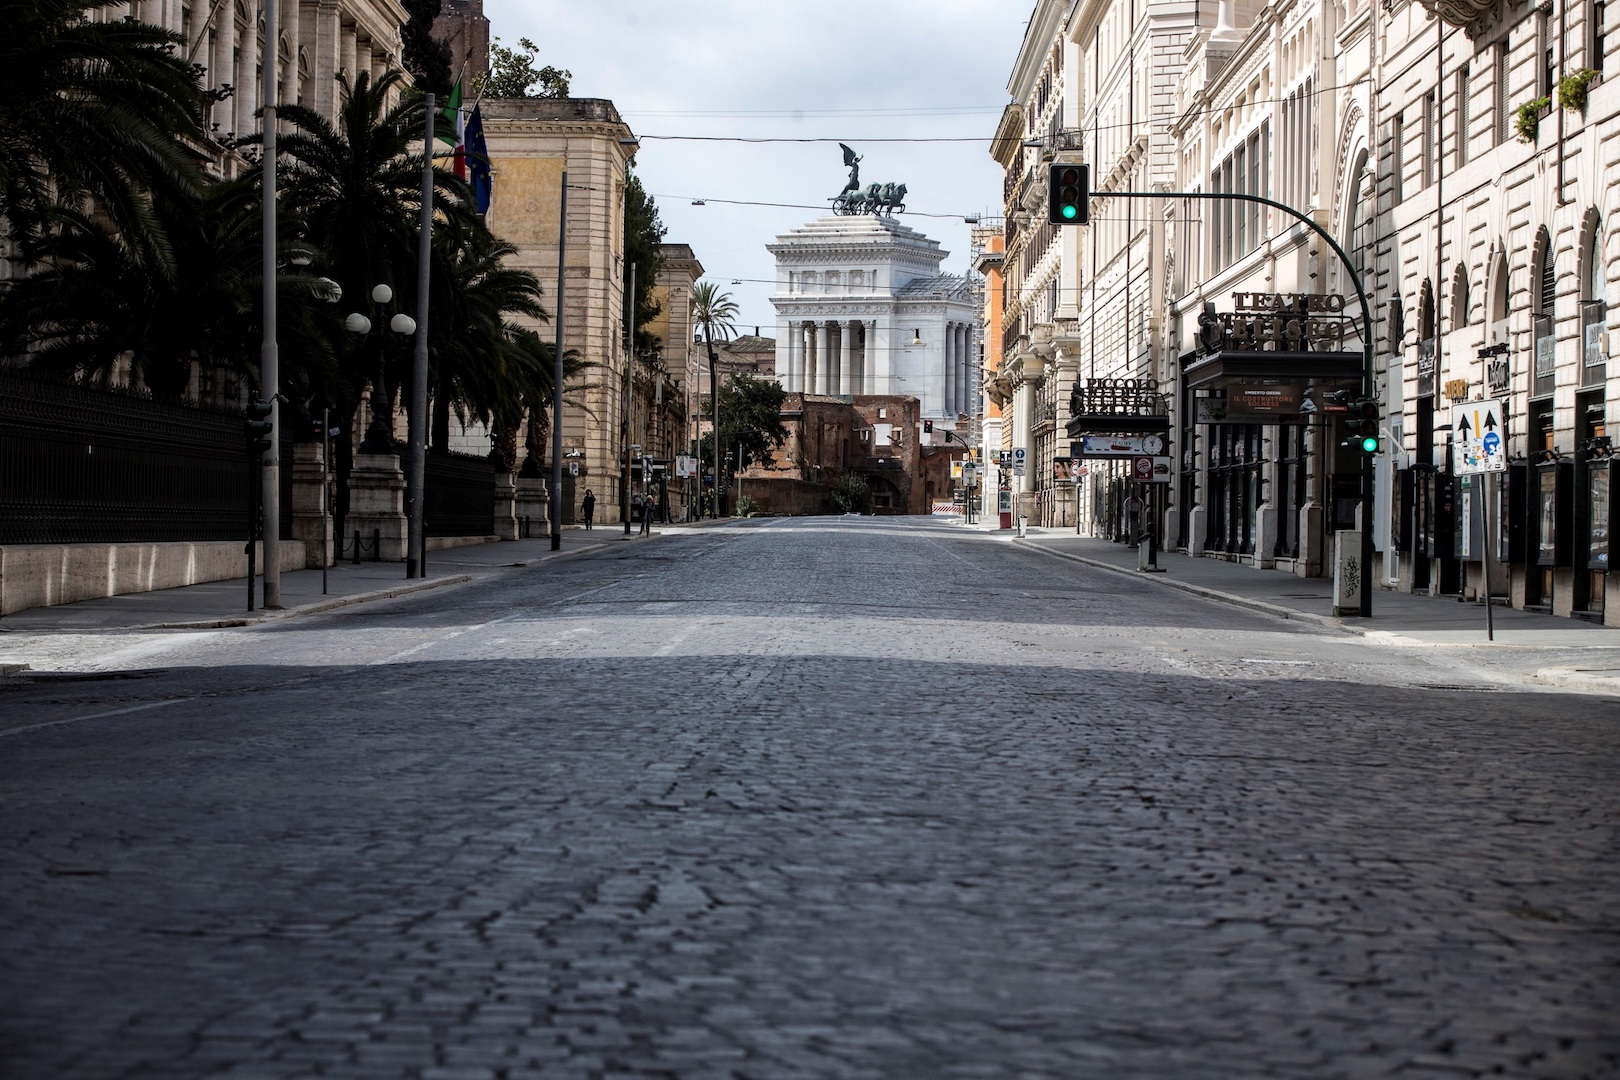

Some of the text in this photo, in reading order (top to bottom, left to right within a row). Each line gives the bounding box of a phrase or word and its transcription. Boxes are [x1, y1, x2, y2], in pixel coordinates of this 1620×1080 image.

[1232, 292, 1345, 312] TEATRO
[1230, 319, 1344, 340] ELISEO
[1086, 378, 1159, 389] PICCOLO
